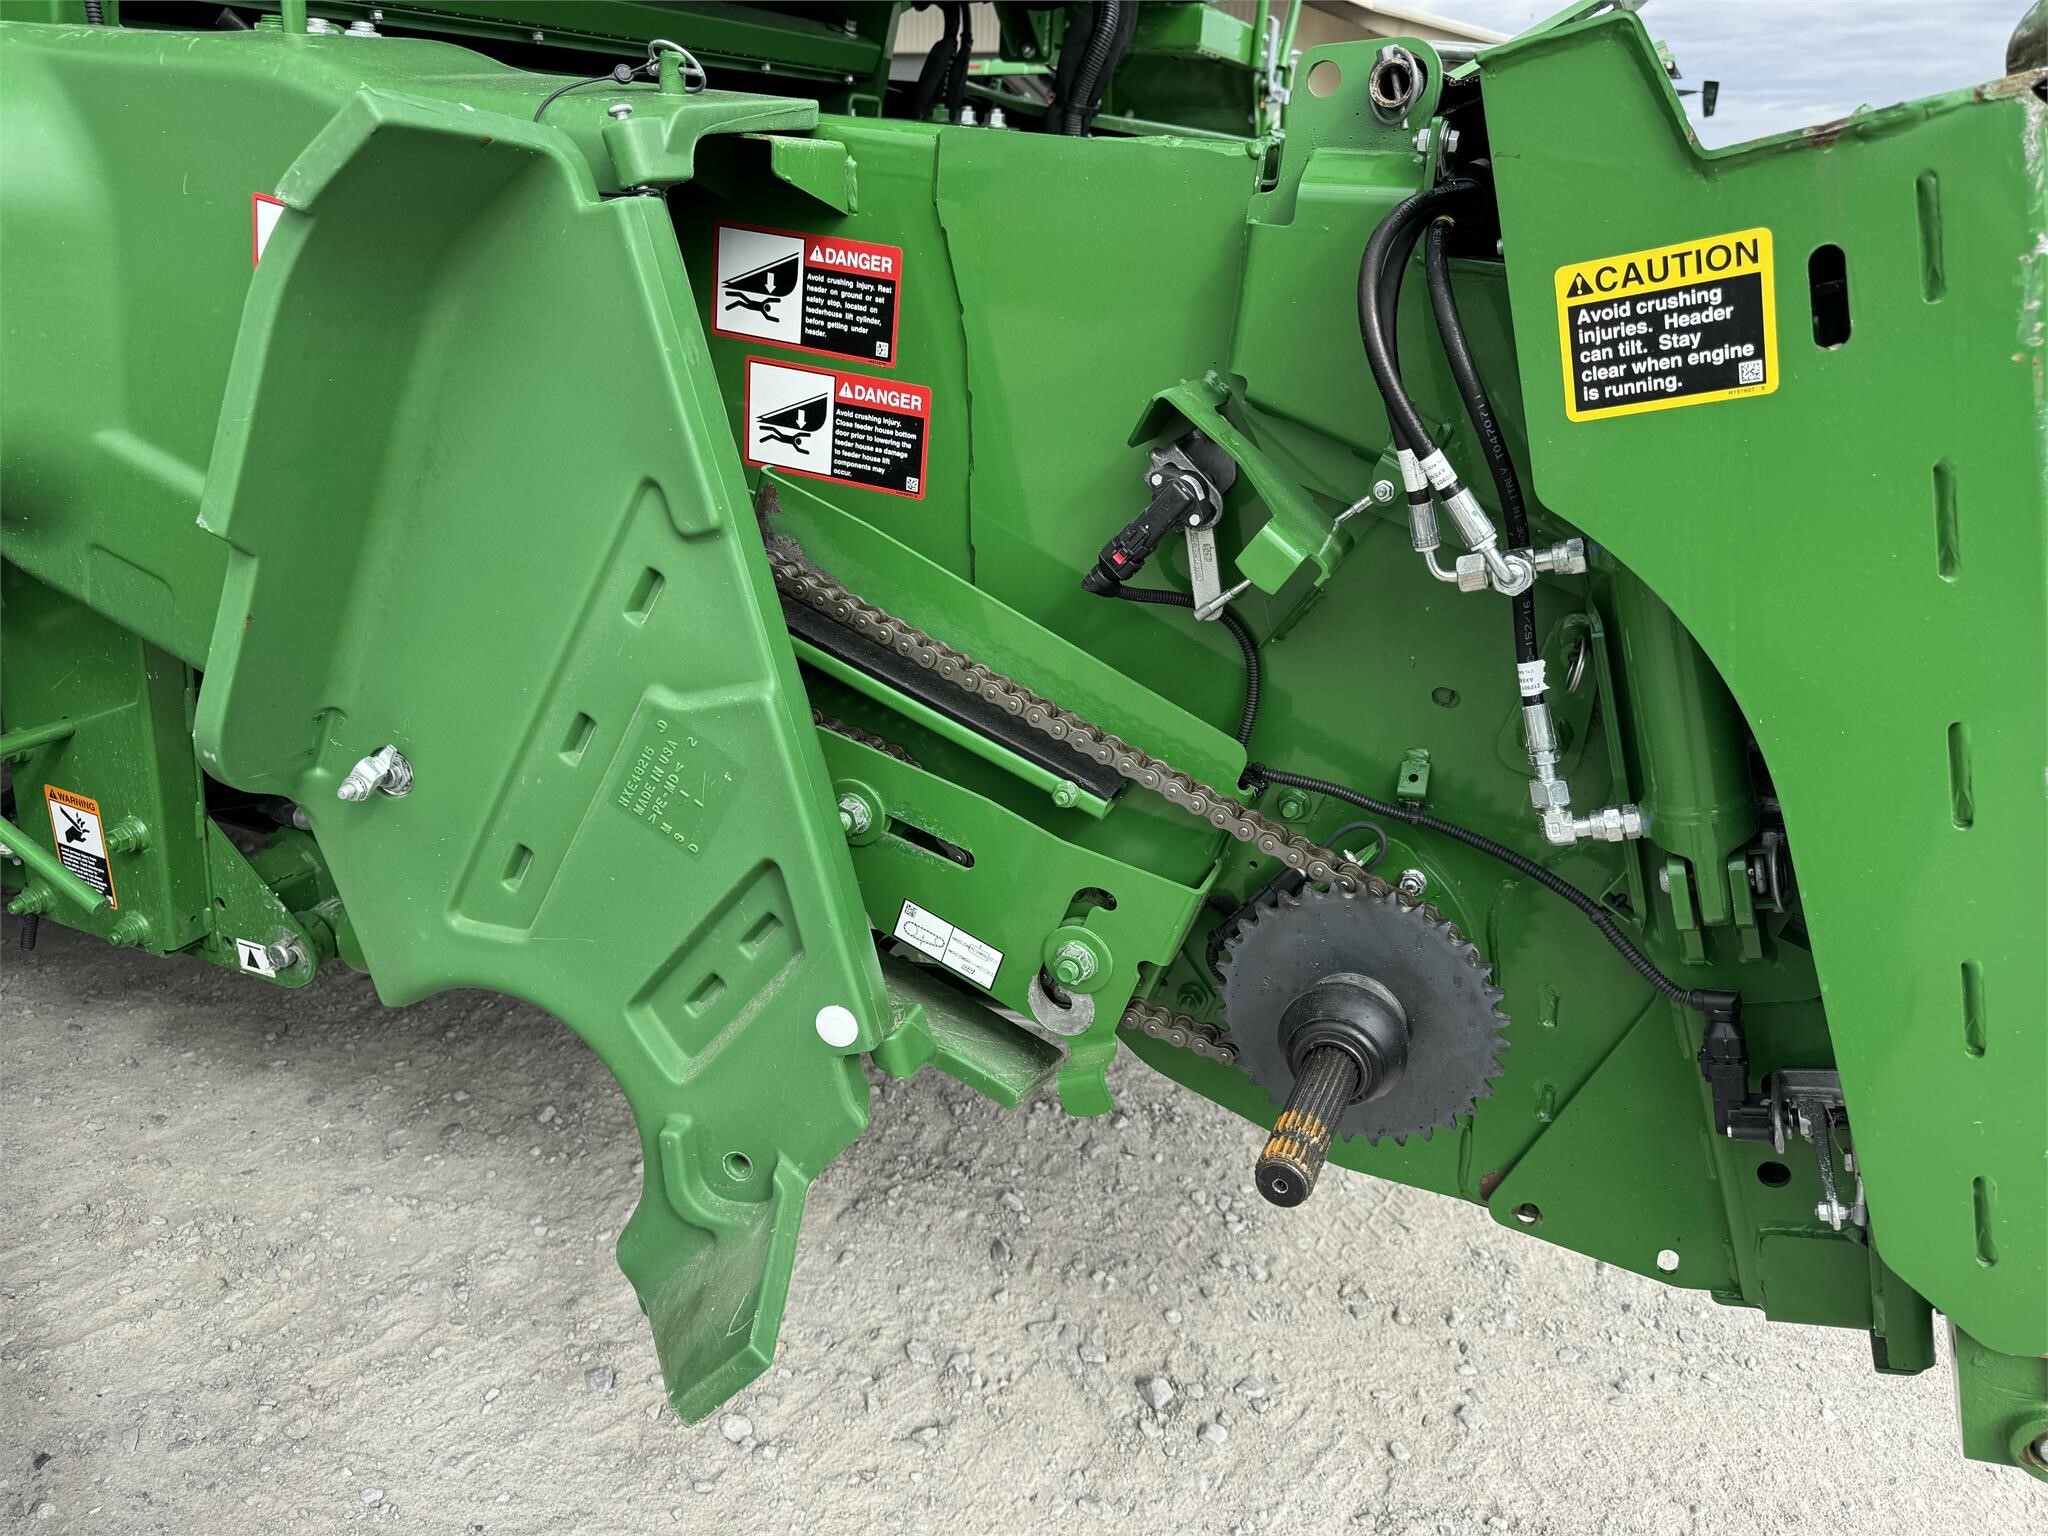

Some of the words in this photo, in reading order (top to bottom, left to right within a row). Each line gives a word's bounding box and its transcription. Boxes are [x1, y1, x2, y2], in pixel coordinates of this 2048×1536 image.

[825, 247, 893, 274] DANGER
[1595, 238, 1759, 292] CAUTION
[807, 273, 824, 282] Avoid
[827, 277, 853, 289] crushing
[856, 281, 875, 292] injury.
[878, 285, 892, 294] Rest
[807, 284, 827, 294] header
[841, 291, 863, 300] ground
[875, 296, 885, 304] set
[806, 295, 824, 306] safety
[827, 299, 842, 309] stop,
[845, 301, 867, 312] located
[1577, 301, 1631, 325] Avoid
[1636, 287, 1722, 315] crushing
[805, 316, 824, 326] before
[827, 320, 848, 332] getting
[851, 325, 869, 334] under
[806, 306, 842, 318] feederhouse
[856, 315, 881, 326] cylinder,
[1578, 320, 1653, 345] injuries.
[1664, 305, 1734, 330] Header
[805, 327, 827, 337] header.
[1580, 347, 1613, 363] can
[1617, 340, 1648, 358] tilt.
[1658, 332, 1701, 350] Stay
[1581, 363, 1627, 382] clear
[1631, 354, 1682, 374] when
[1687, 343, 1755, 366] engine
[854, 385, 922, 412] DANGER
[1583, 386, 1600, 401] is
[1604, 376, 1683, 399] running.
[836, 409, 854, 418] Avoid
[854, 413, 881, 424] crushing
[883, 417, 901, 428] injury.
[835, 419, 854, 428] Close
[854, 422, 873, 432] feeder
[875, 425, 894, 436] house
[895, 429, 917, 440] bottom
[835, 429, 850, 437] door
[850, 432, 866, 441] prior
[874, 436, 900, 449] lowering
[901, 441, 912, 449] the
[834, 438, 854, 448] feeder
[855, 442, 874, 451] house
[884, 448, 908, 459] damage
[842, 450, 861, 459] feeder
[862, 454, 881, 463] house
[882, 457, 891, 465] lift
[833, 459, 871, 471] components
[872, 466, 885, 475] may
[833, 469, 852, 477] occur.
[1500, 467, 1518, 500] ITALY
[618, 745, 655, 808] HXE48215
[632, 782, 656, 816] MADE
[650, 765, 665, 782] IN
[658, 739, 678, 765] USA
[57, 791, 96, 812] WARNING
[660, 821, 673, 834] M
[673, 832, 685, 843] S
[688, 843, 699, 854] D
